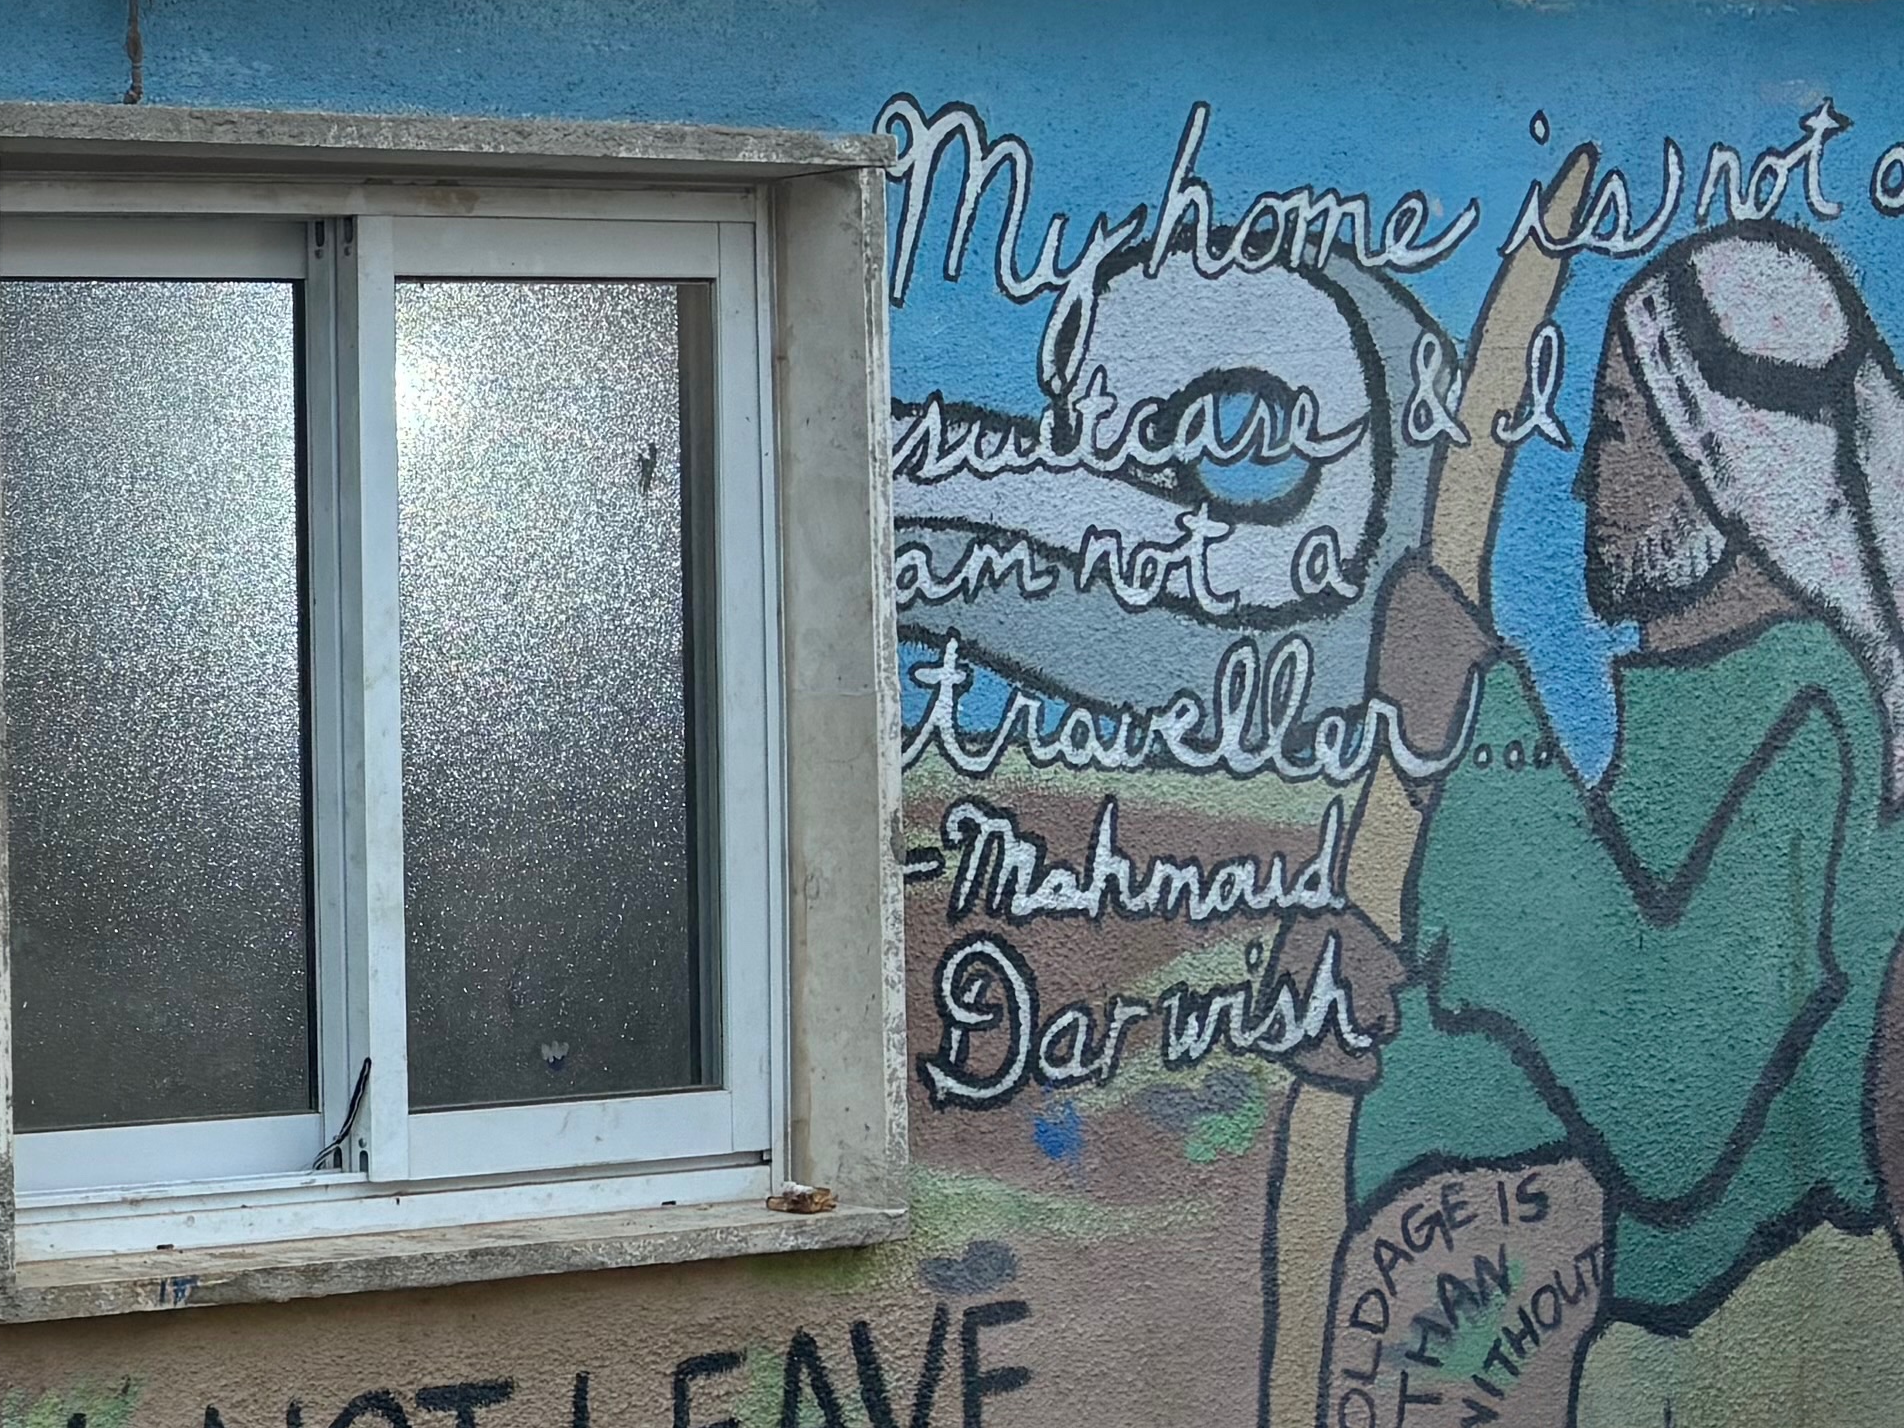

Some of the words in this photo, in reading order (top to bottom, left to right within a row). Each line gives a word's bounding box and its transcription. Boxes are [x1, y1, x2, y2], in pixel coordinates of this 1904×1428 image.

[875, 94, 1142, 387] My
[1145, 101, 1479, 282] home
[1498, 110, 1682, 258] is
[1696, 97, 1853, 225] not
[892, 362, 1367, 483] suitcase
[1404, 336, 1469, 446] &
[894, 539, 1061, 608] am
[1081, 499, 1239, 613] not
[1295, 526, 1366, 601] a
[917, 930, 1383, 1112] Darwish
[1496, 1170, 1552, 1225] IS
